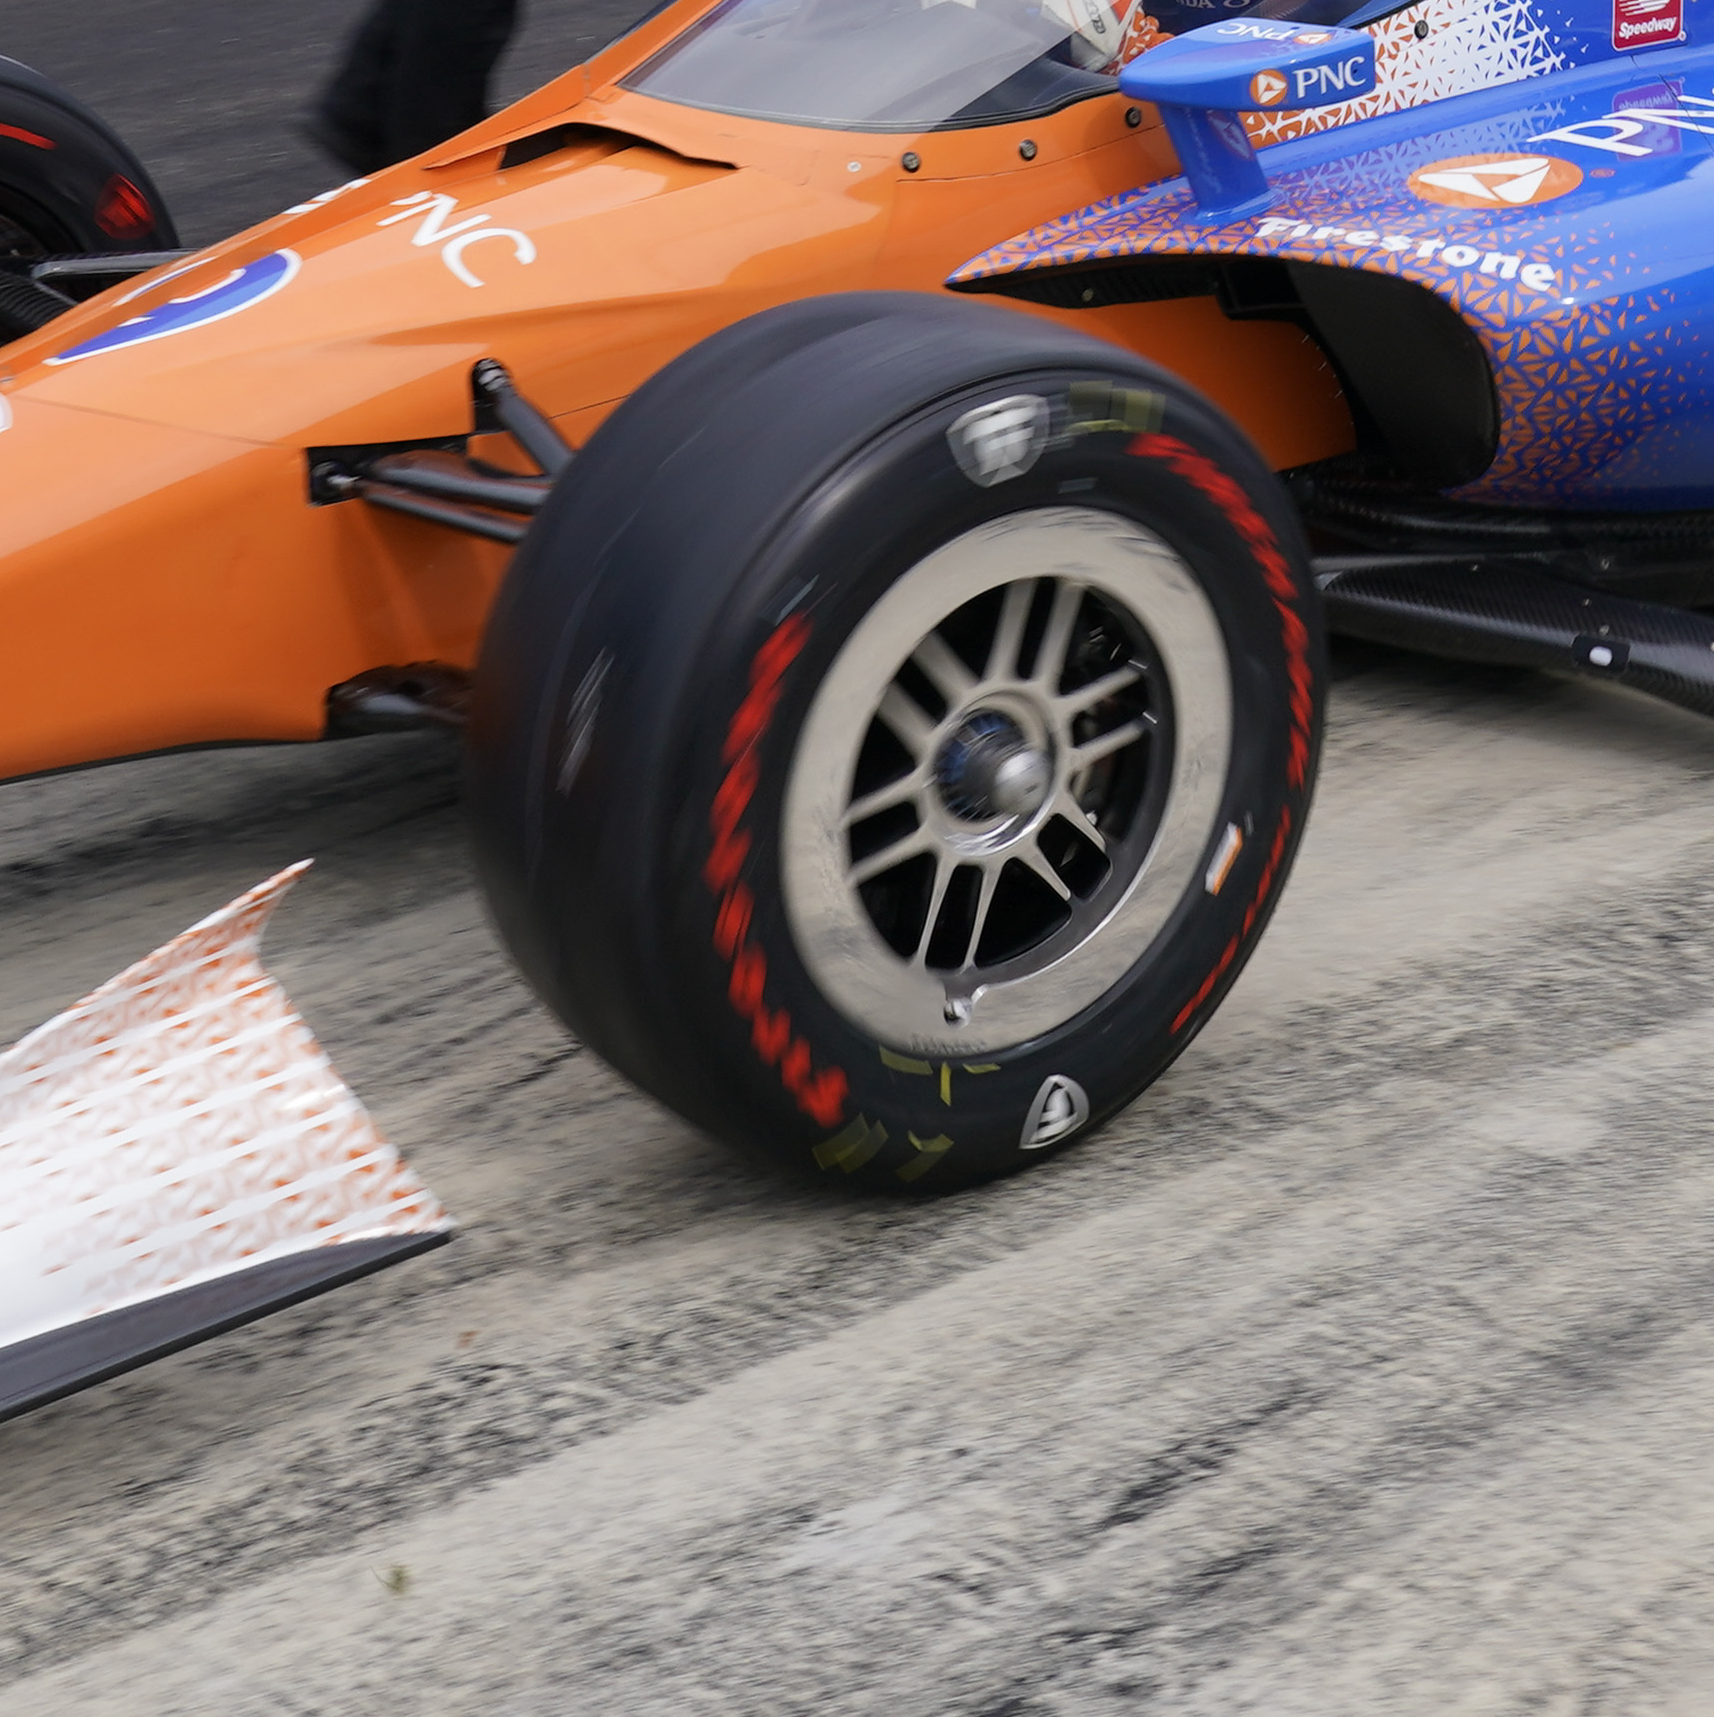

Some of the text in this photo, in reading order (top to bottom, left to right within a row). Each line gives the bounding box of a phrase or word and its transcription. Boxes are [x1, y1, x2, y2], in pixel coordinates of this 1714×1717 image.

[1618, 16, 1677, 40] Speedway
[1292, 55, 1366, 99] PNC
[375, 190, 537, 288] NC
[1256, 216, 1557, 292] Firestone
